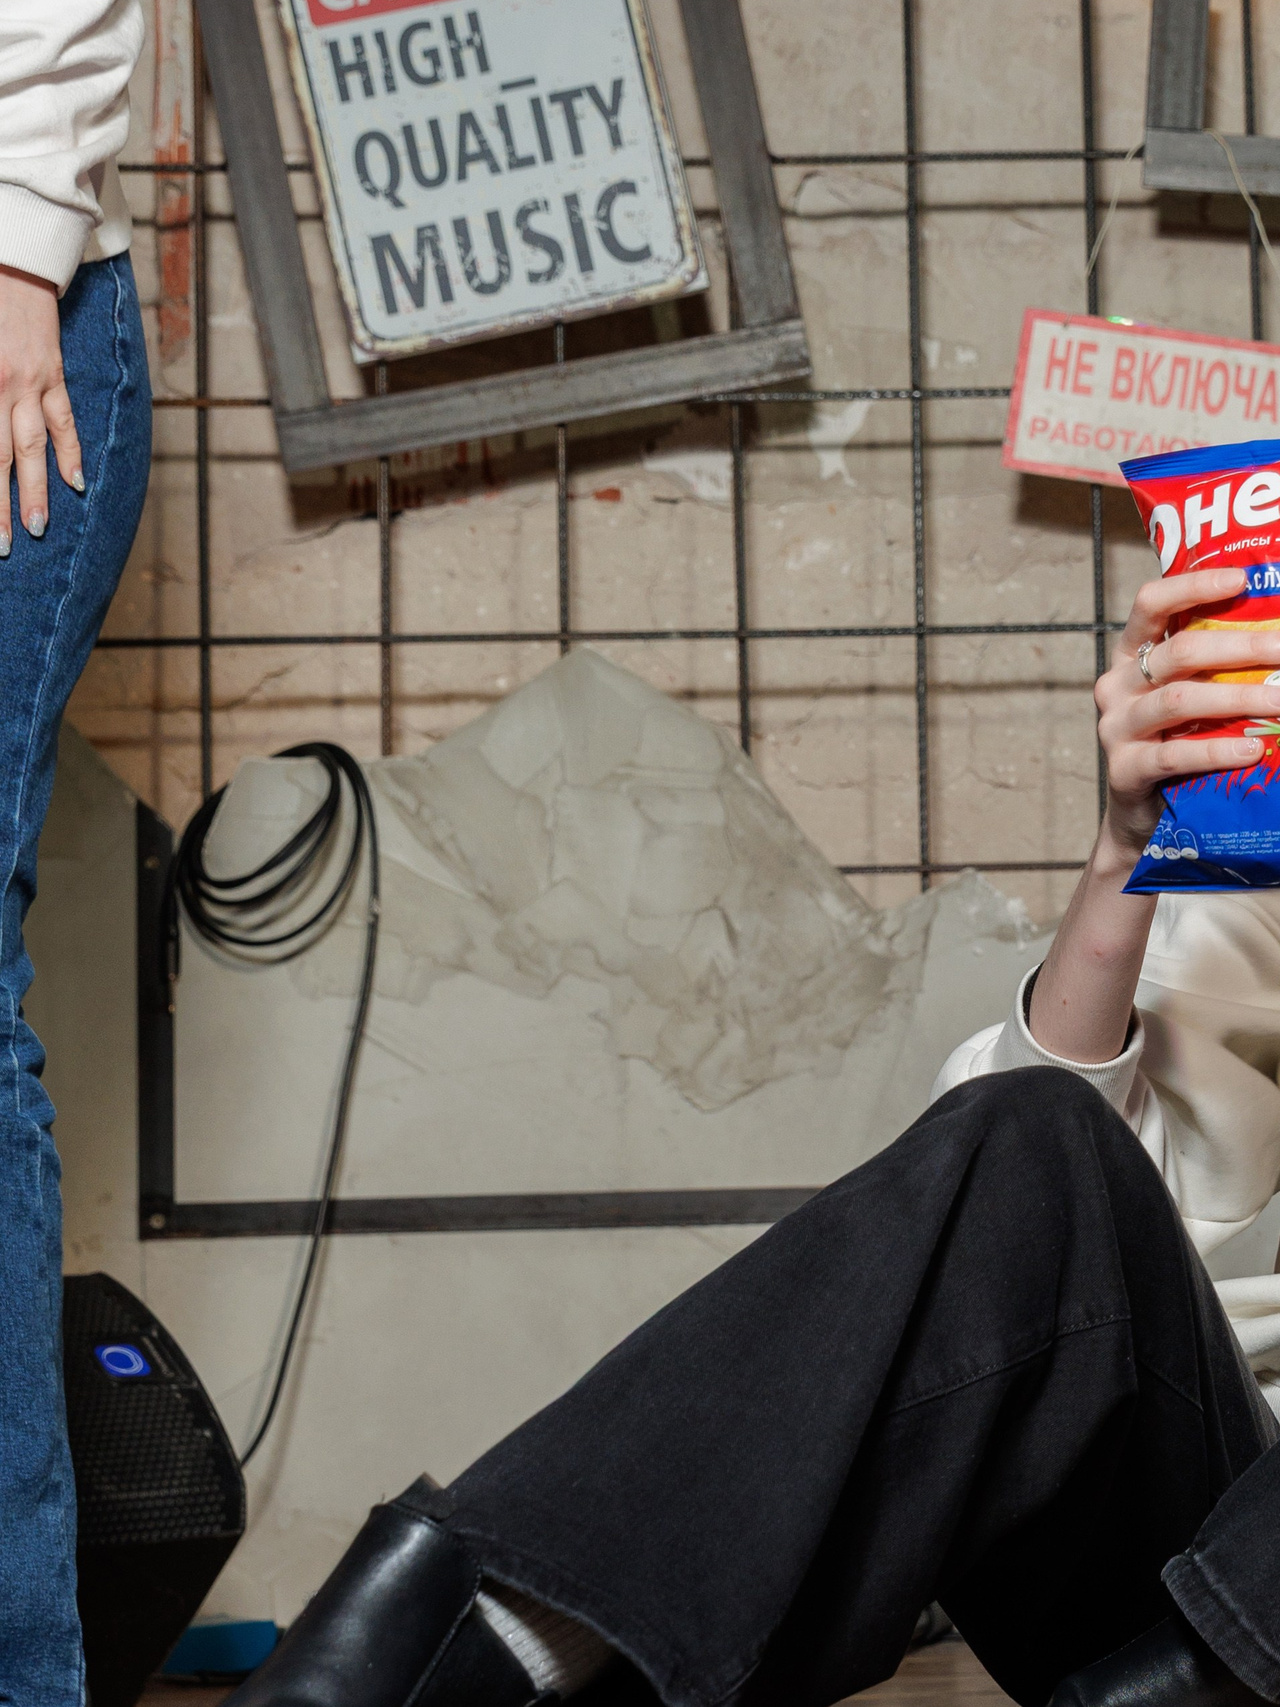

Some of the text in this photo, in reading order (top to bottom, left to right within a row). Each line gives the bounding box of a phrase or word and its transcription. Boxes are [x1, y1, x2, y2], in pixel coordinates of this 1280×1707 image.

[353, 78, 626, 209] QUALITY
[367, 179, 652, 315] MUSIC
[1043, 336, 1100, 395] НЕ
[1029, 415, 1208, 454] РАБОТАЮ
